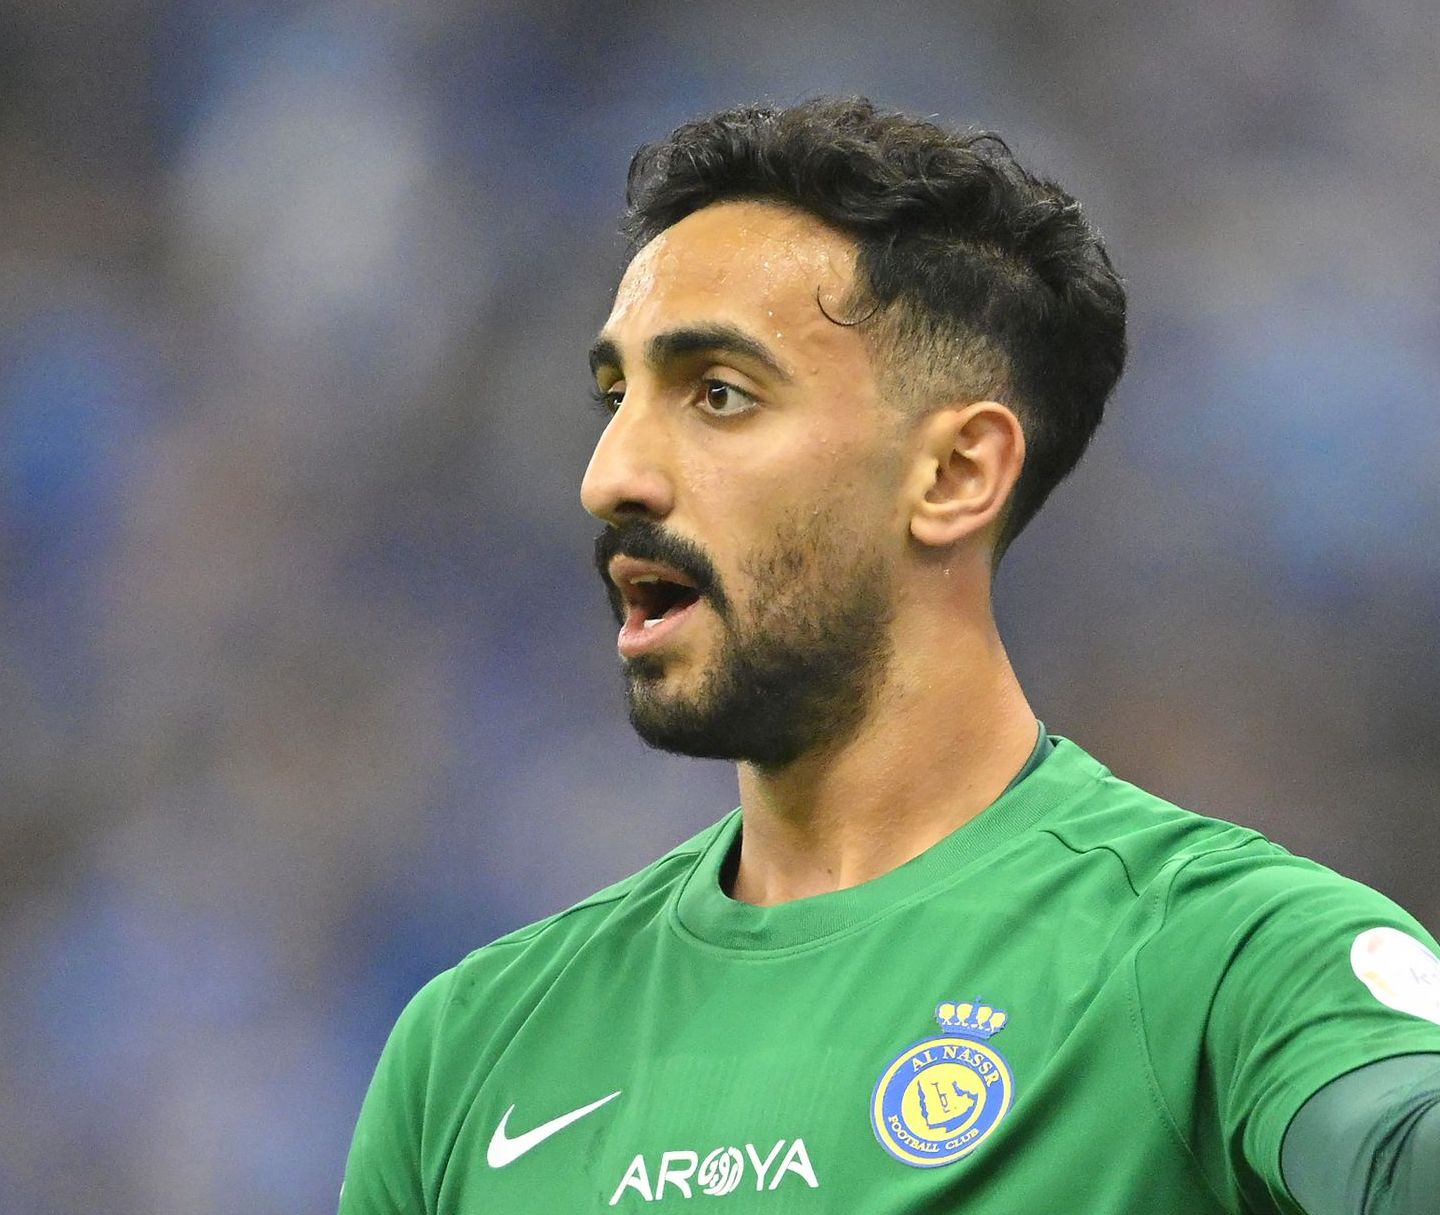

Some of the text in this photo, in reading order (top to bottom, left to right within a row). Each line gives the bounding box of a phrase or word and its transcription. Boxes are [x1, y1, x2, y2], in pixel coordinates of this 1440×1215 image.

[911, 1045, 1001, 1087] AL NASSR
[887, 1114, 980, 1153] FOOTBALL CLUB
[608, 1137, 820, 1206] AROYA
